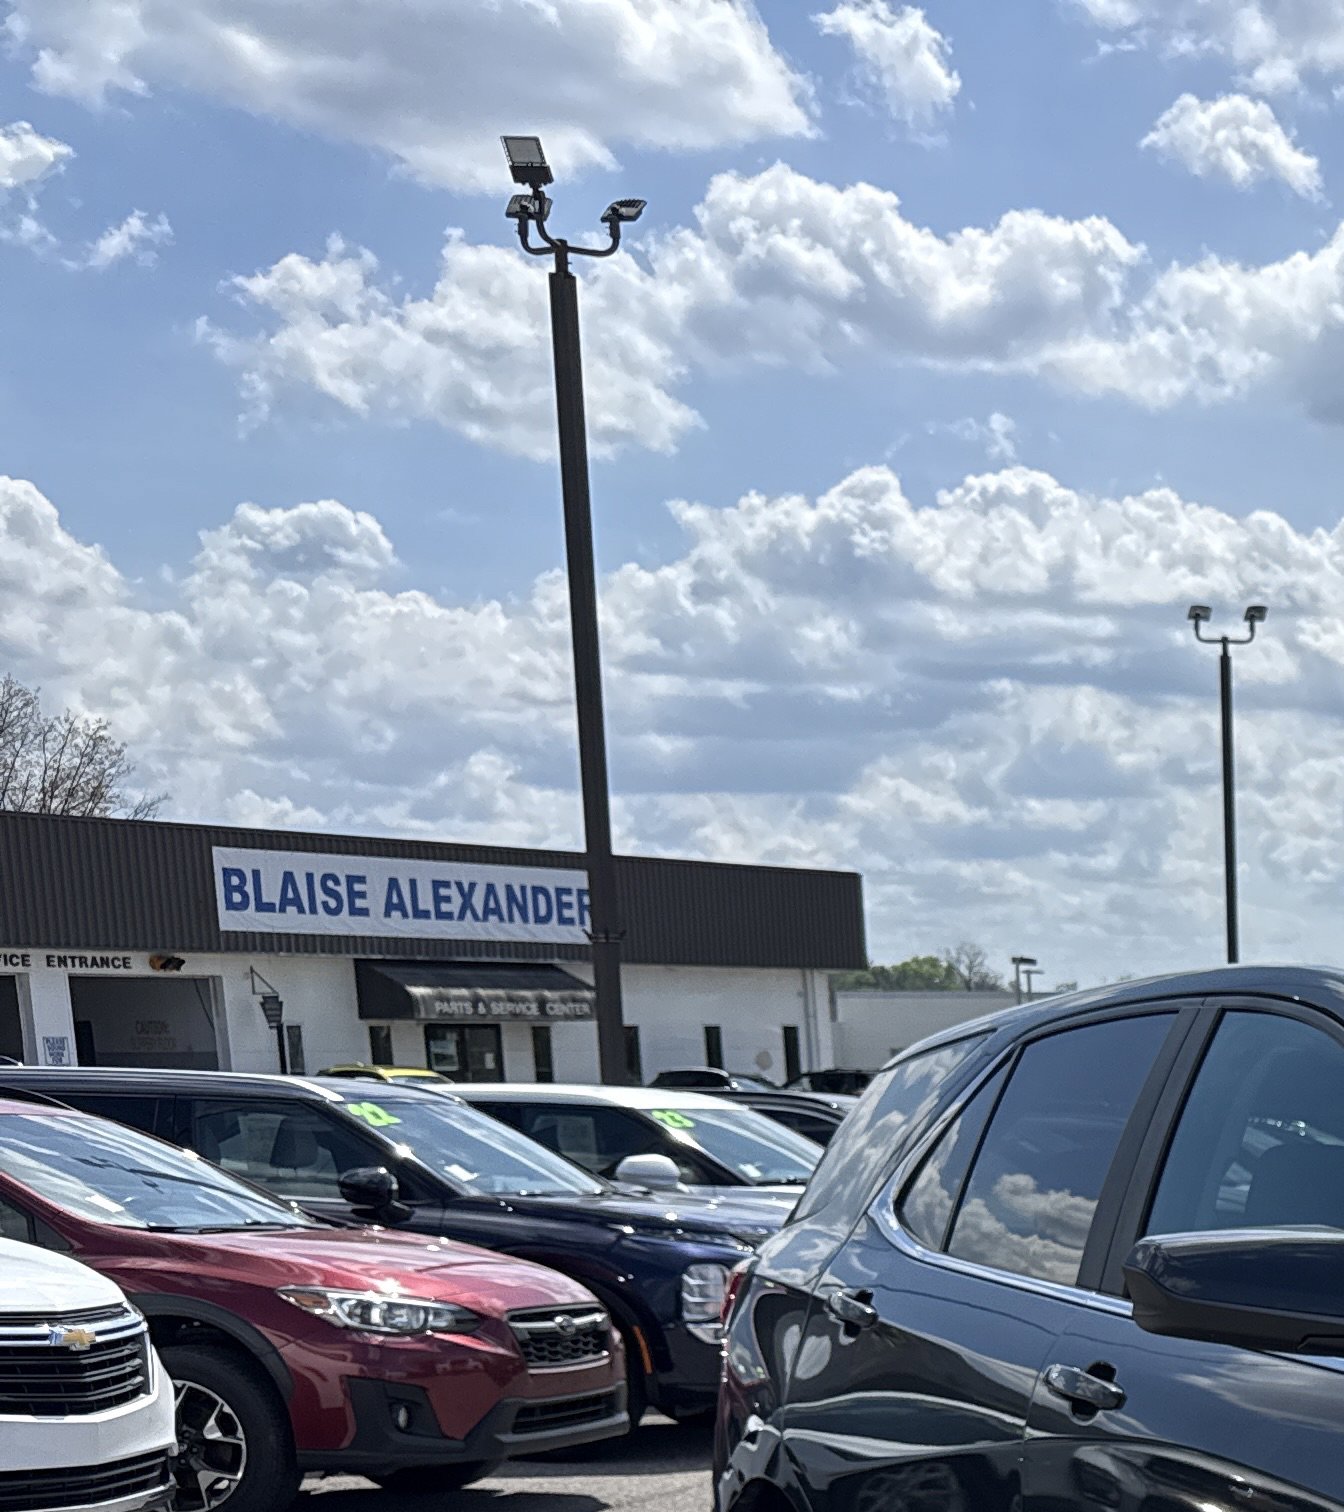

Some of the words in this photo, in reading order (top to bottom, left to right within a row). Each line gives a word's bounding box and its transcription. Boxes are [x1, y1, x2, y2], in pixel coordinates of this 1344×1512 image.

[221, 867, 370, 918] BLAISE
[0, 953, 32, 968] ICE
[45, 954, 133, 970] ENTRANCE
[434, 1001, 473, 1015] PARTS
[477, 1002, 486, 1015] &
[489, 1001, 540, 1016] SERVICE
[545, 1002, 592, 1016] CENTER
